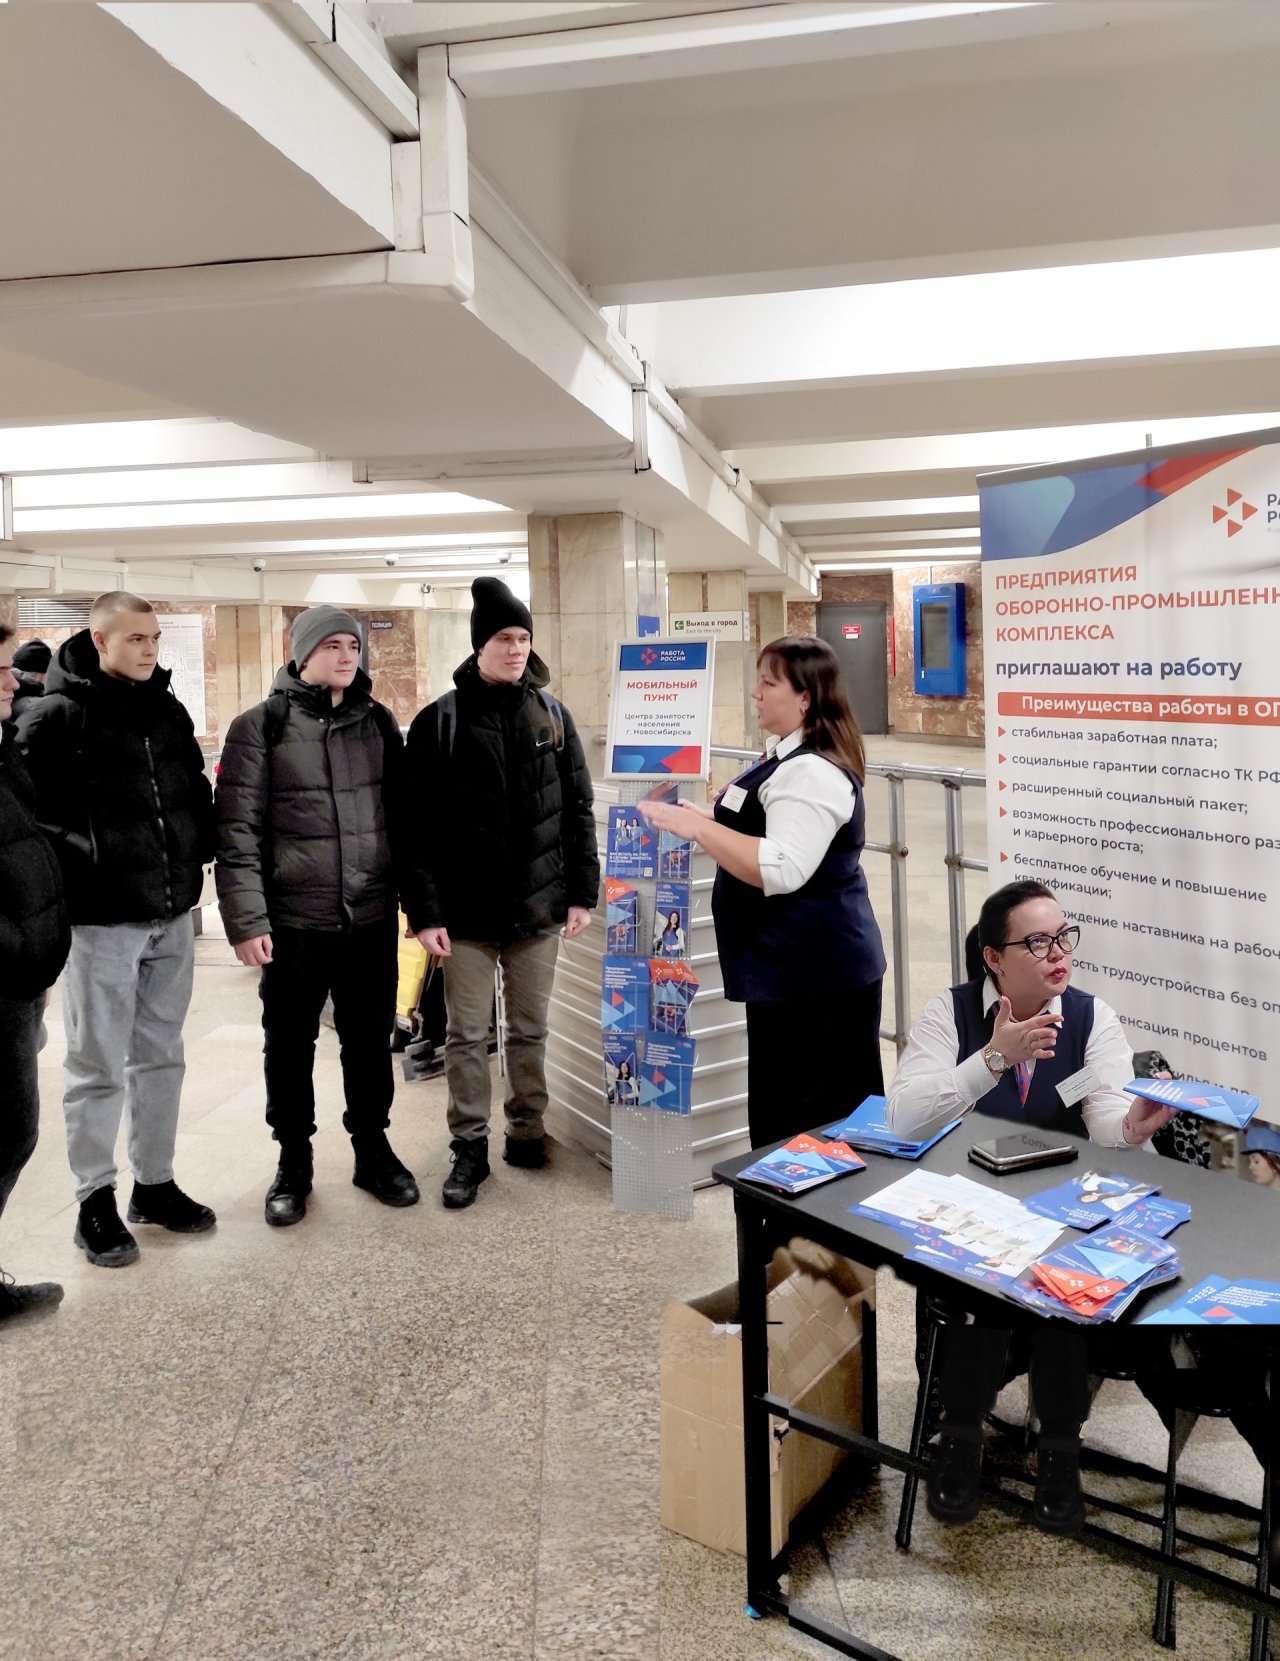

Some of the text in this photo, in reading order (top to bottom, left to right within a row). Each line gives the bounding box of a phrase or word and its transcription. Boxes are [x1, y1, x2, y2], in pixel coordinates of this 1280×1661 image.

[995, 565, 1137, 590] ПРЕДПРИЯТИЯ
[996, 624, 1115, 642] КОМПЛЕКСА
[996, 657, 1243, 680] приглашают на работу
[627, 680, 697, 689] МОБИЛЬНЫЙ
[1021, 696, 1153, 716] Преимущества
[1158, 698, 1232, 717] работы
[1238, 704, 1249, 716] в
[1011, 726, 1218, 749] стабильная заработная плата;
[1012, 754, 1089, 769] социальные
[1093, 761, 1157, 775] гарантии
[1161, 765, 1230, 781] согласно
[1234, 768, 1253, 781] ТК
[1012, 781, 1248, 814] расширенный социальный пакет;
[1013, 809, 1096, 828] возможность
[1100, 818, 1250, 846] профессионального
[1013, 828, 1144, 854] и карьерного роста;
[1014, 853, 1267, 902] бесплатное обучение и повышение
[1122, 920, 1205, 946] наставника
[1209, 937, 1229, 950] на
[1102, 965, 1225, 1001] трудоустройства
[1231, 991, 1257, 1008] без
[1117, 1014, 1268, 1062] енсация процентов
